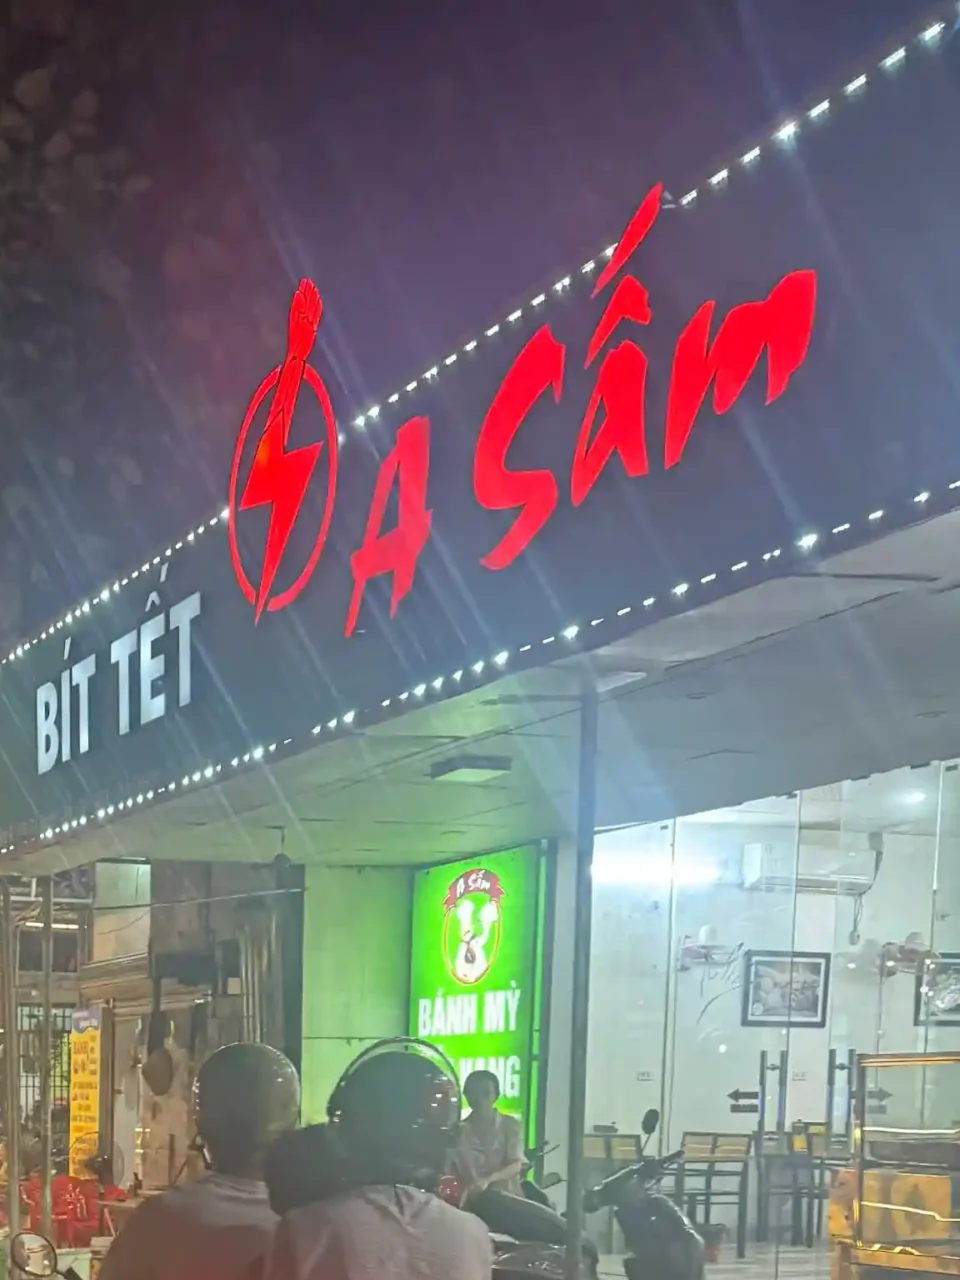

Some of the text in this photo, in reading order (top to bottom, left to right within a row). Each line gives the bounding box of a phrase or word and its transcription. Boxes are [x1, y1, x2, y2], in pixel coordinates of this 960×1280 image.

[344, 182, 817, 638] A Sấm
[36, 561, 202, 775] BÍT TẾT
[418, 979, 521, 1037] BÁNH MỲ
